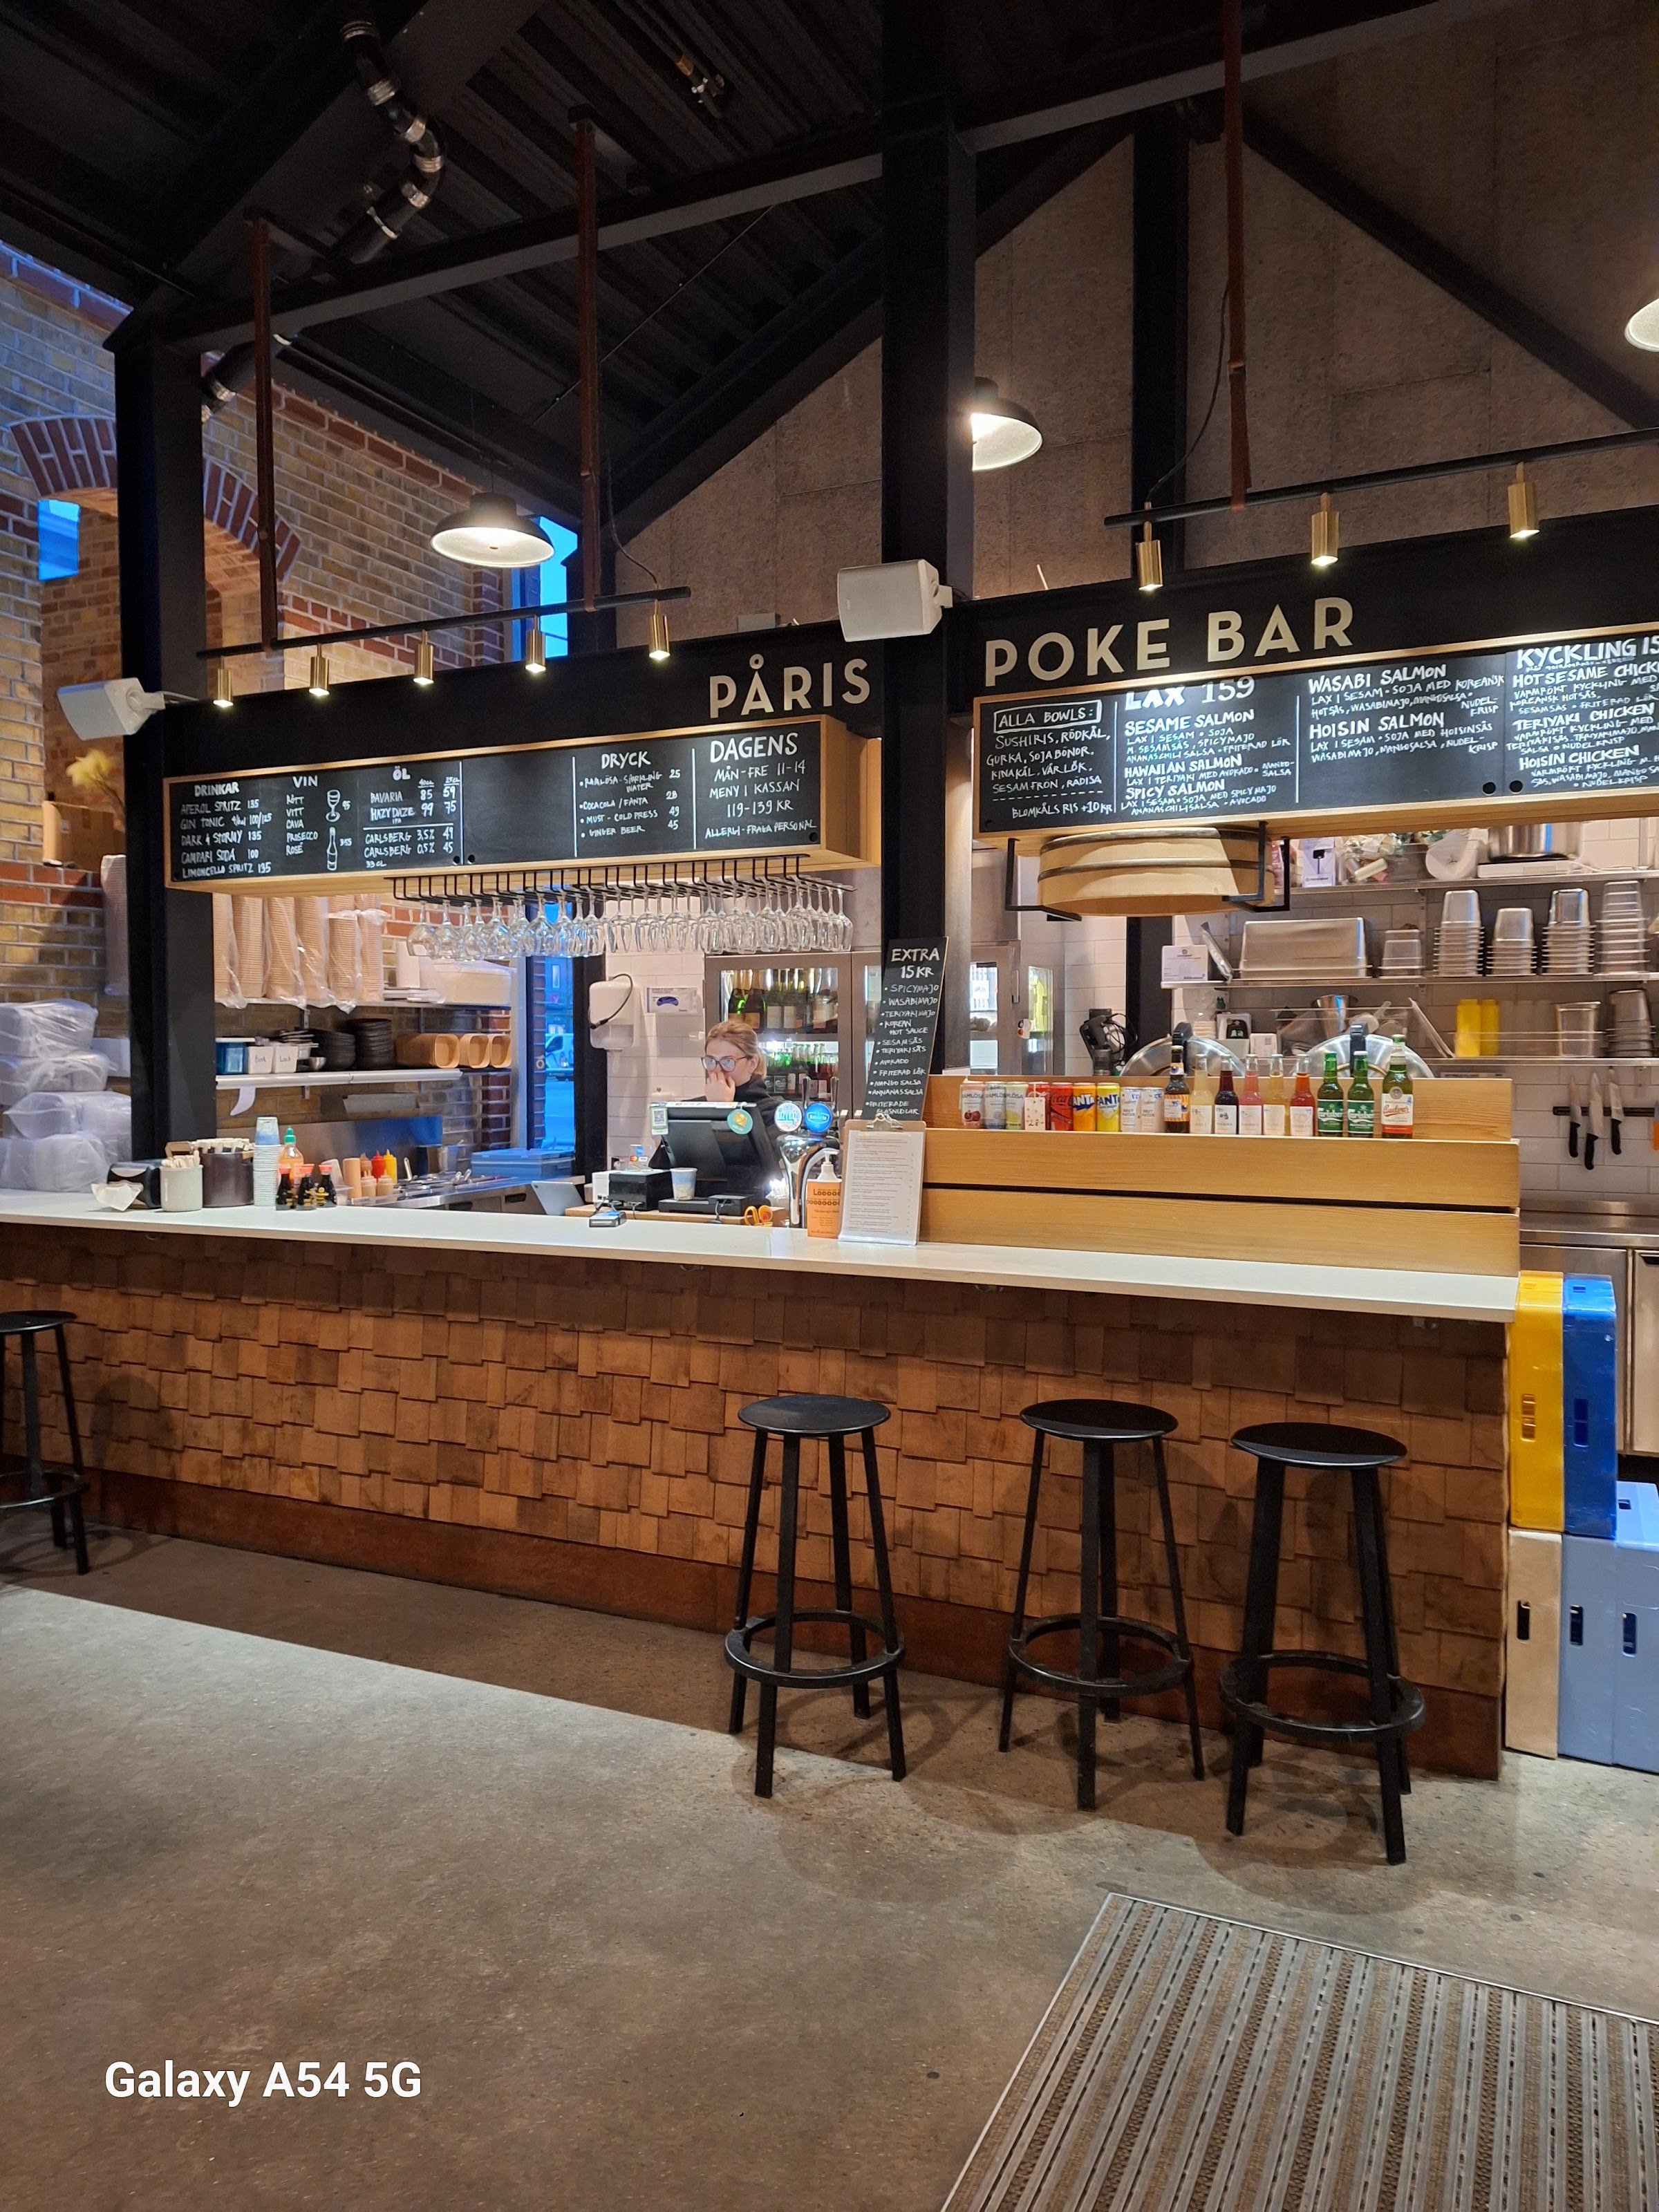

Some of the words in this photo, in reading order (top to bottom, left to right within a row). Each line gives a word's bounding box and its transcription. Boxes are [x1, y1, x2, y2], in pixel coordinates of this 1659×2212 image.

[986, 619, 1170, 687] POKE
[1208, 597, 1353, 662] BAR
[1517, 639, 1637, 669] KYCKLING
[710, 654, 870, 719] PÅRIS
[1309, 673, 1371, 695] WASABI
[1380, 664, 1446, 685] SALMON
[1630, 675, 1658, 686] MED
[1125, 685, 1185, 711] LAX
[1201, 676, 1255, 703] 159
[1312, 695, 1332, 705] LAX
[1344, 687, 1383, 701] SESAM
[1392, 684, 1423, 695] SOJA
[1425, 679, 1452, 692] MED
[1455, 675, 1505, 691] KOREANSK
[998, 713, 1035, 728] ALLA
[1043, 707, 1094, 724] BOWLS:
[1125, 716, 1191, 736] SESAME
[1194, 709, 1255, 728] SALMON
[1512, 713, 1580, 731] TERIYAKI
[1590, 702, 1655, 721] CHICKEN
[1630, 716, 1654, 726] MED
[1309, 718, 1369, 740] HOISIN
[1378, 712, 1445, 731] SALMON
[1127, 735, 1147, 745] LAX
[1159, 731, 1194, 743] SESAM
[1208, 727, 1234, 736] SOJA
[1198, 733, 1255, 747] SPICYMAJO
[1311, 741, 1329, 753] LAX
[1341, 735, 1376, 748] SESAM
[1385, 731, 1409, 742] SOJA
[1414, 729, 1436, 738] MED
[711, 732, 798, 763] DAGENS
[1468, 741, 1499, 753] KRISP
[601, 751, 651, 769] DRYCK
[986, 753, 1027, 767] GURKA,
[1124, 761, 1185, 778] HAWAIIAN
[1189, 753, 1242, 772] SALMON
[1519, 752, 1565, 771] HOISIN
[1568, 744, 1640, 765] CHICKEN
[393, 765, 411, 781] ÖL
[668, 769, 681, 779] 25
[777, 759, 806, 776] 11-14
[1262, 769, 1291, 777] SALSA
[292, 775, 317, 788] VIN
[1127, 778, 1143, 787] LAX
[1199, 771, 1218, 780] MED
[194, 782, 239, 797] DRINKAR
[371, 791, 403, 804] BAVARIA
[420, 789, 433, 800] 85
[442, 786, 456, 799] 59
[626, 782, 654, 793] WATER
[709, 785, 739, 799] MENY
[754, 778, 800, 795] KASSAN
[1125, 785, 1165, 800] SPICY
[1168, 778, 1225, 796] SALMON
[214, 800, 241, 812] SPRITZ
[247, 799, 260, 809] 135
[421, 802, 433, 817] 99
[444, 800, 457, 814] 75
[1121, 800, 1138, 810] LAX
[1182, 794, 1206, 804] SOJA
[1210, 791, 1228, 800] MED
[1230, 796, 1266, 805] AVOCADO
[286, 807, 304, 817] VITT
[586, 814, 605, 824] MUST
[614, 813, 632, 822] COLD
[634, 809, 658, 820] PRESS
[668, 806, 679, 816] 49
[727, 800, 773, 818] 119-139
[776, 800, 794, 812] KR
[1062, 803, 1078, 814] RIS
[1100, 803, 1113, 816] KR
[180, 818, 196, 830] GIN
[286, 819, 304, 830] CAVA
[621, 825, 646, 835] BEER
[668, 820, 679, 830] 45
[774, 819, 817, 831] PERSONAL
[181, 835, 203, 847] DARK
[248, 831, 263, 841] 135
[286, 831, 318, 843] PROSECCO
[365, 832, 412, 844] CARLSBERG
[442, 827, 453, 840] 49
[247, 849, 259, 859] 100
[286, 842, 303, 856] ROSÉ
[364, 844, 412, 858] CARLSBERG
[442, 841, 453, 854] 45
[228, 863, 254, 874] SPRITZ
[258, 862, 272, 874] 135
[891, 947, 940, 962] EXTRA
[901, 965, 915, 979] 15
[916, 966, 935, 978] KR
[890, 984, 939, 993] SPICYMAJO
